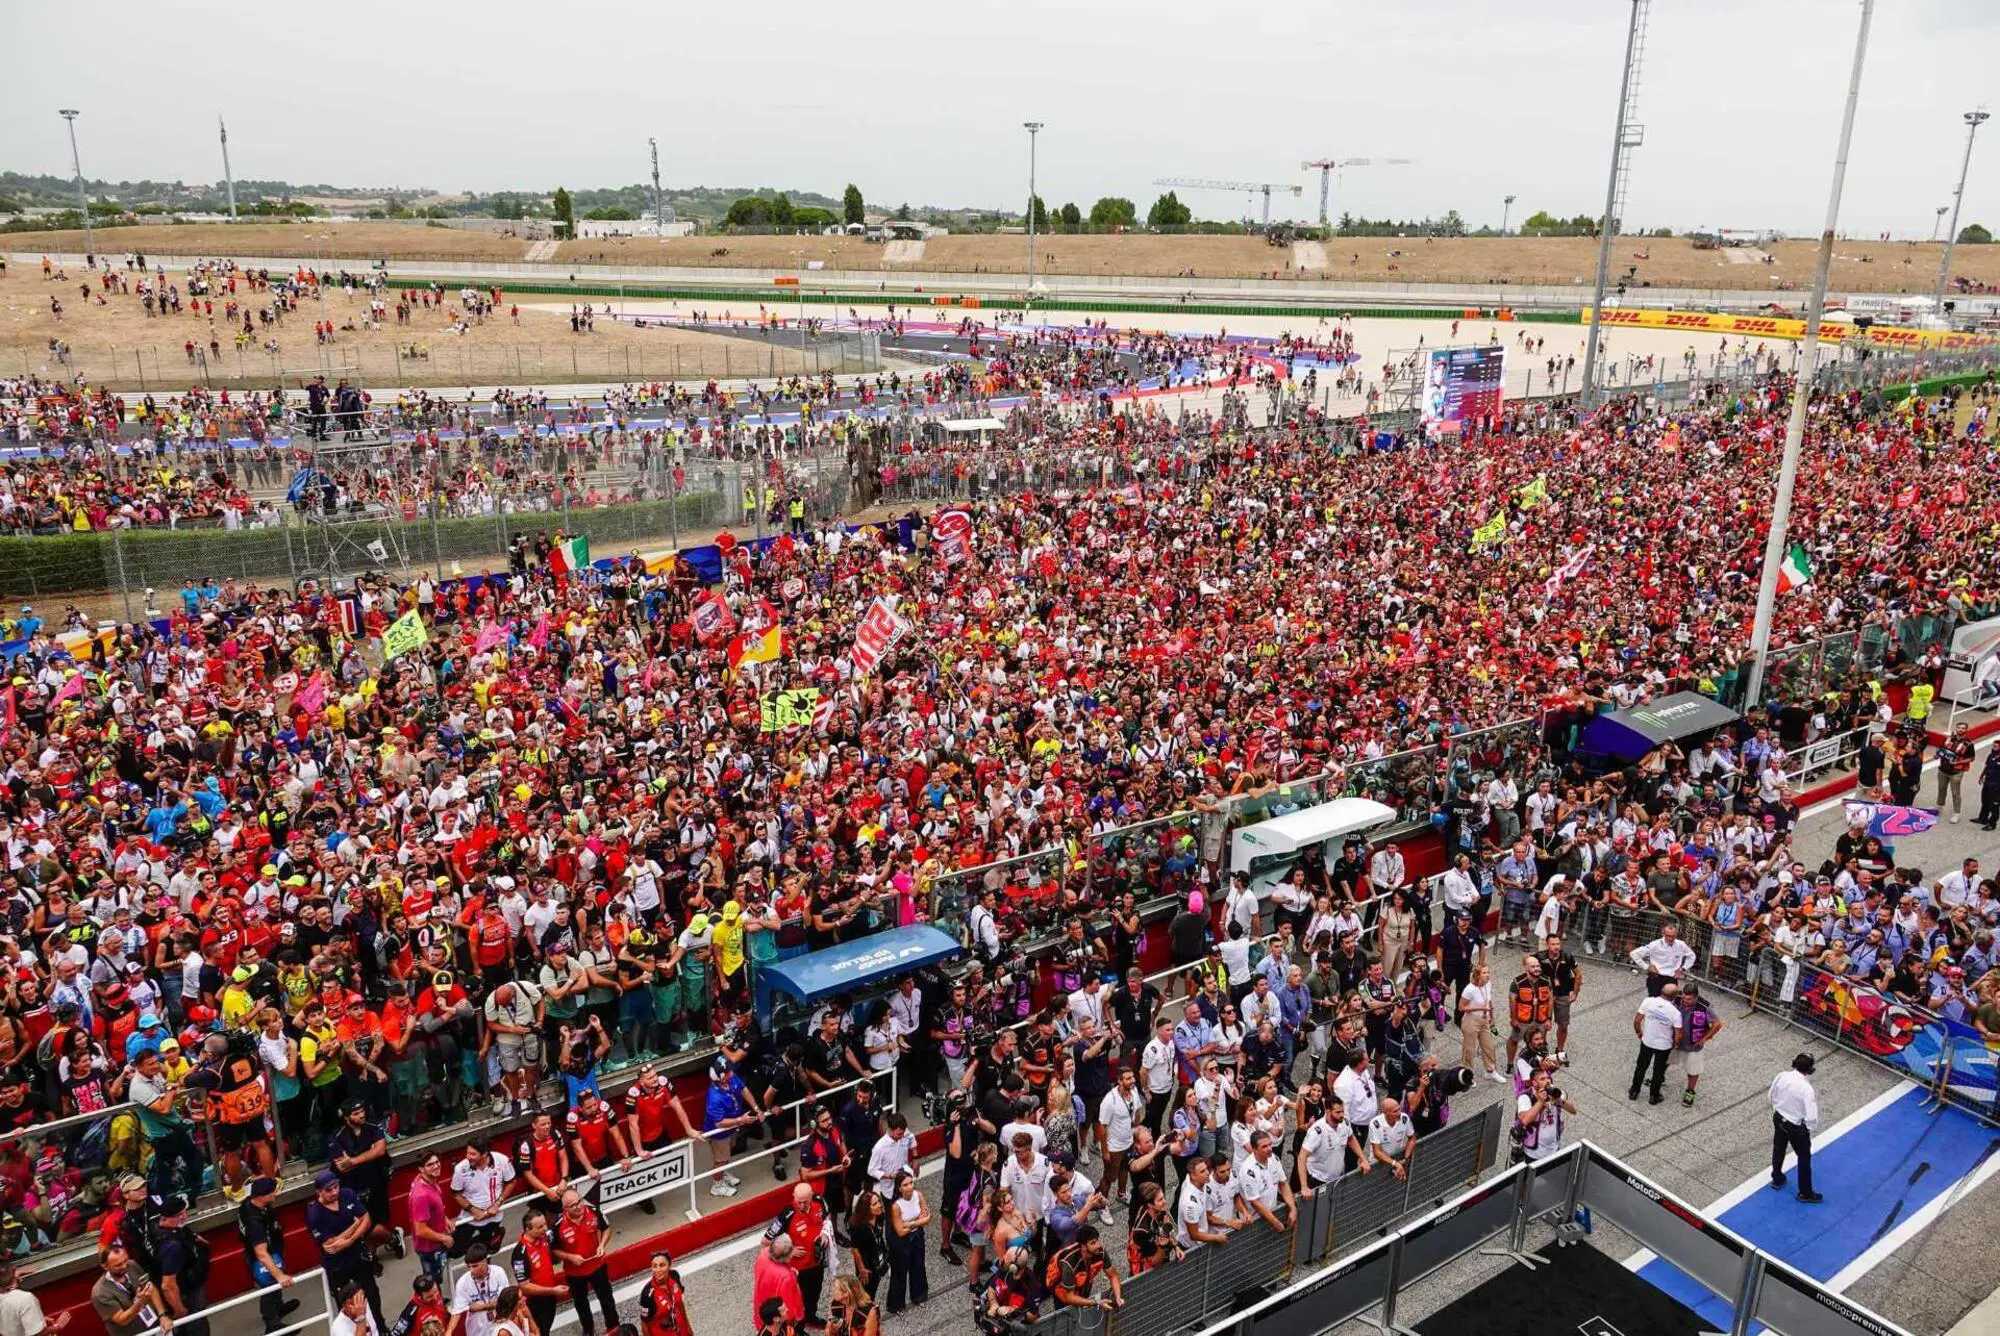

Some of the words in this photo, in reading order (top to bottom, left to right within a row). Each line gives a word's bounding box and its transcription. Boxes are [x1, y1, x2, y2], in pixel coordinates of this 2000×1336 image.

[1599, 311, 1642, 324] DHL
[1664, 314, 1711, 328] DHL
[1732, 318, 1777, 333] DHL
[1871, 330, 1922, 346] DHL
[220, 929, 238, 945] 93
[239, 1095, 262, 1114] 139
[604, 1171, 658, 1196] TRACK
[663, 1164, 678, 1177] IN
[1627, 1176, 1661, 1200] MotoGP
